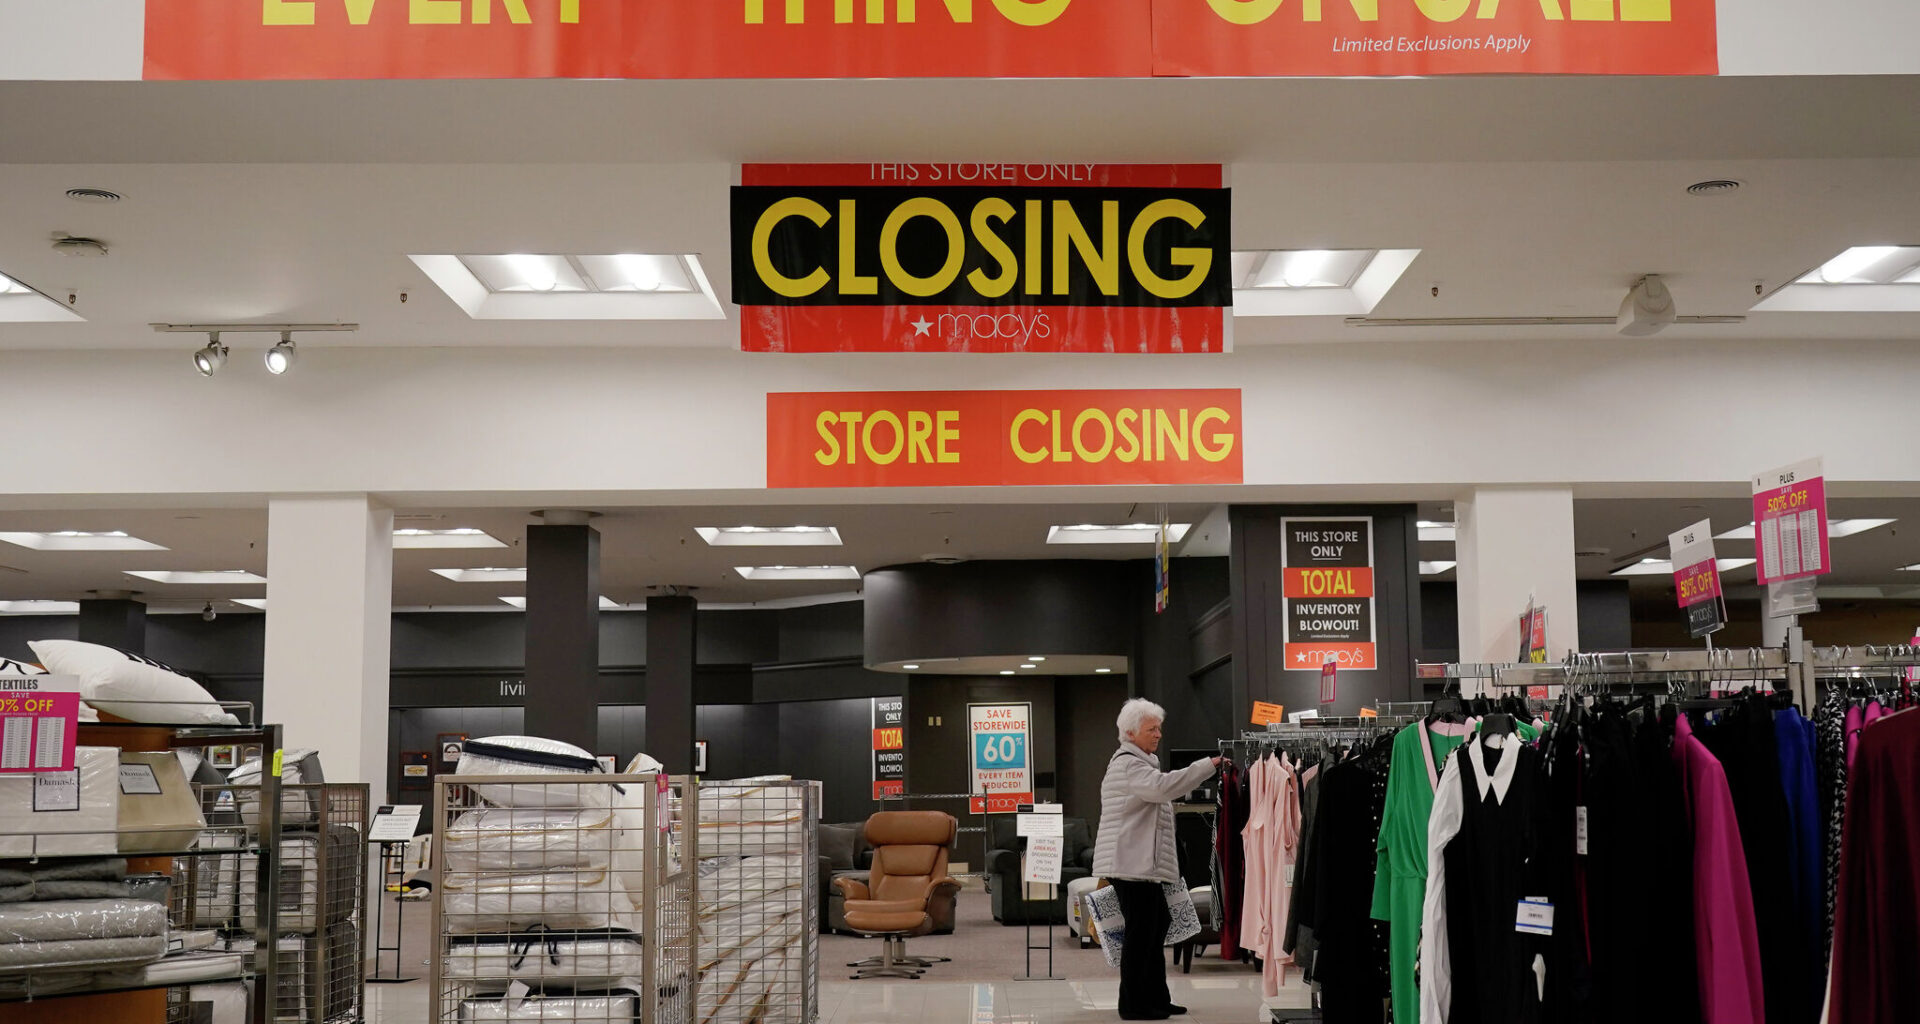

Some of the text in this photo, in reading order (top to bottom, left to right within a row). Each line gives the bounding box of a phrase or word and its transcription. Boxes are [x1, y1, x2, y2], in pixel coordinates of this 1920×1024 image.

[1332, 33, 1531, 53] Limited Exclusions Apply
[870, 163, 1096, 181] THIS STORE ONLY
[751, 197, 1213, 299] CLOSING
[938, 308, 1051, 346] macy's
[814, 407, 1235, 466] STORE CLOSING
[1779, 471, 1795, 485] PLUS
[1768, 495, 1787, 512] 50%
[1790, 490, 1807, 507] OFF
[1295, 531, 1358, 543] THIS STORE
[1683, 533, 1695, 544] PLUS
[1310, 545, 1344, 557] ONLY
[1301, 570, 1355, 595] TOTAL
[1680, 572, 1712, 598] 50% OFF
[1296, 603, 1362, 616] INVENTORY
[1299, 619, 1360, 632] BLOWOUT!
[25, 699, 53, 712] OFF
[878, 703, 891, 712] THIS
[885, 712, 902, 721] ONLY
[986, 709, 1012, 719] SAVE
[973, 720, 1027, 731] STOREWIDE
[983, 735, 1023, 762] 60%
[978, 771, 1023, 780] EVERY ITEM
[981, 780, 1021, 790] REDUCED!
